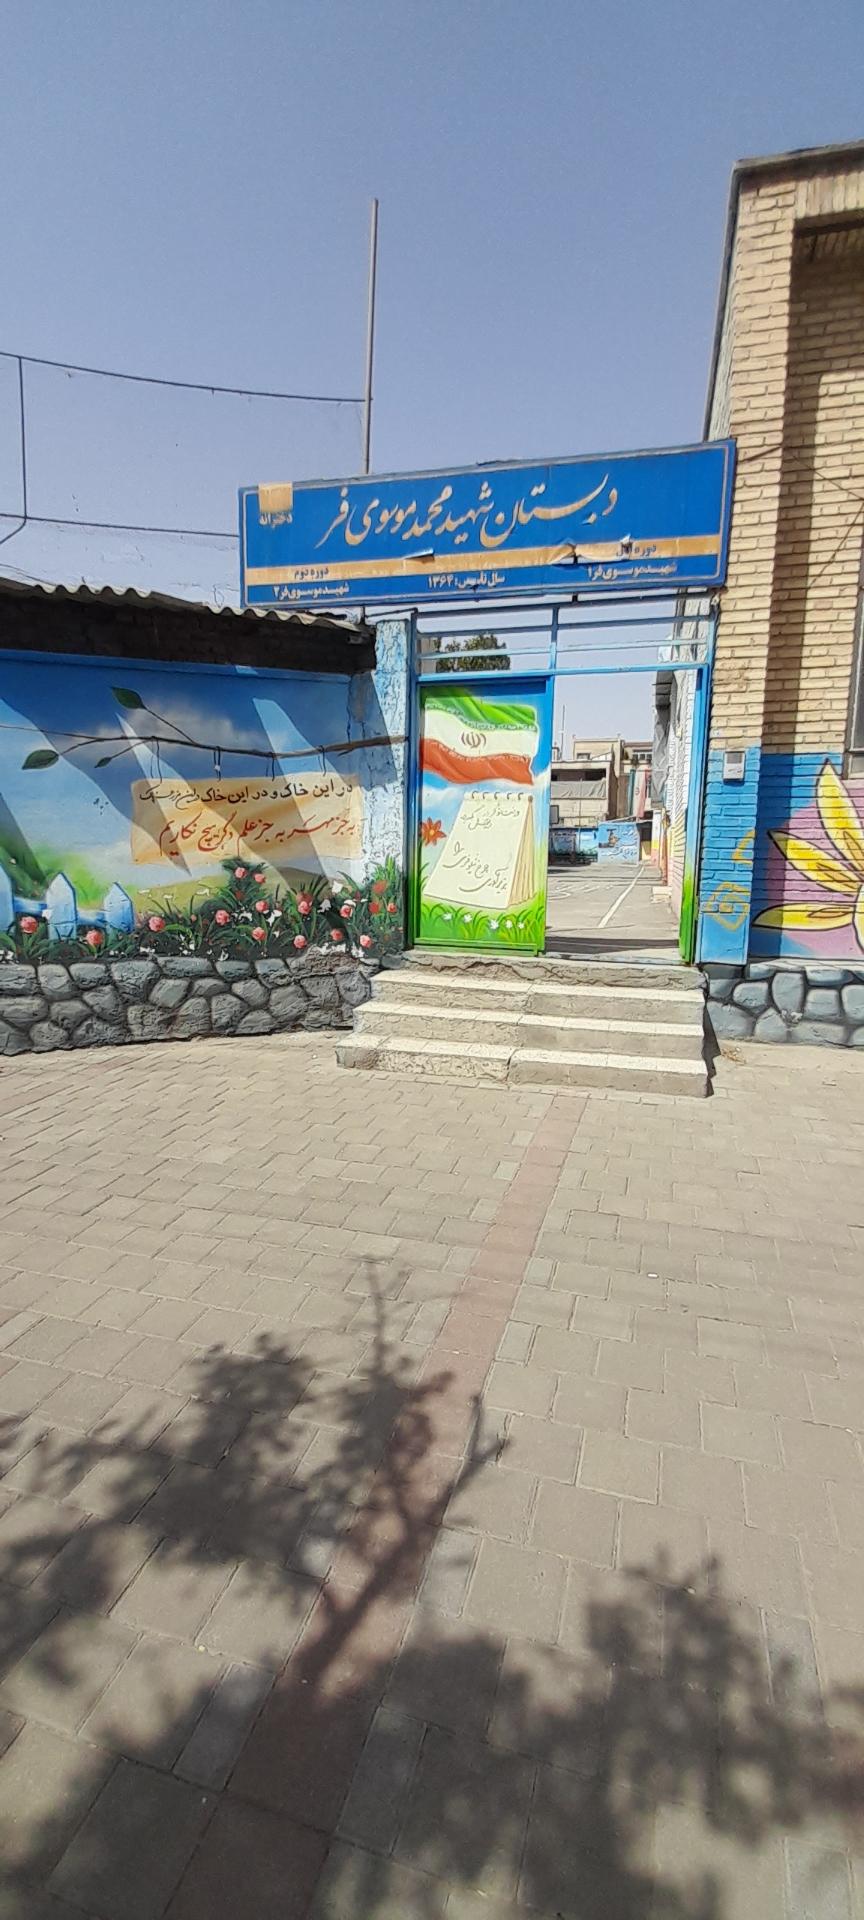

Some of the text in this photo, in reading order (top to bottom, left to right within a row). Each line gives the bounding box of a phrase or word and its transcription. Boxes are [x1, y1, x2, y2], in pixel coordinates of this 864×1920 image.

[315, 474, 617, 548] دبستان شهید محمد موسوی فر
[294, 567, 329, 580] دوره دوم
[487, 571, 506, 587] سال
[322, 582, 350, 596] شهید
[201, 787, 226, 802] خاک
[228, 786, 249, 803] این
[251, 788, 268, 800] در
[270, 790, 279, 799] و
[280, 782, 308, 798] خاک
[312, 779, 334, 798] این
[335, 784, 353, 796] در
[159, 811, 203, 857] نکاریم
[254, 819, 274, 842] جز
[287, 814, 335, 839] مهر
[332, 816, 350, 836] جز
[346, 824, 356, 835] به
[236, 819, 257, 857] علم
[275, 831, 285, 842] به
